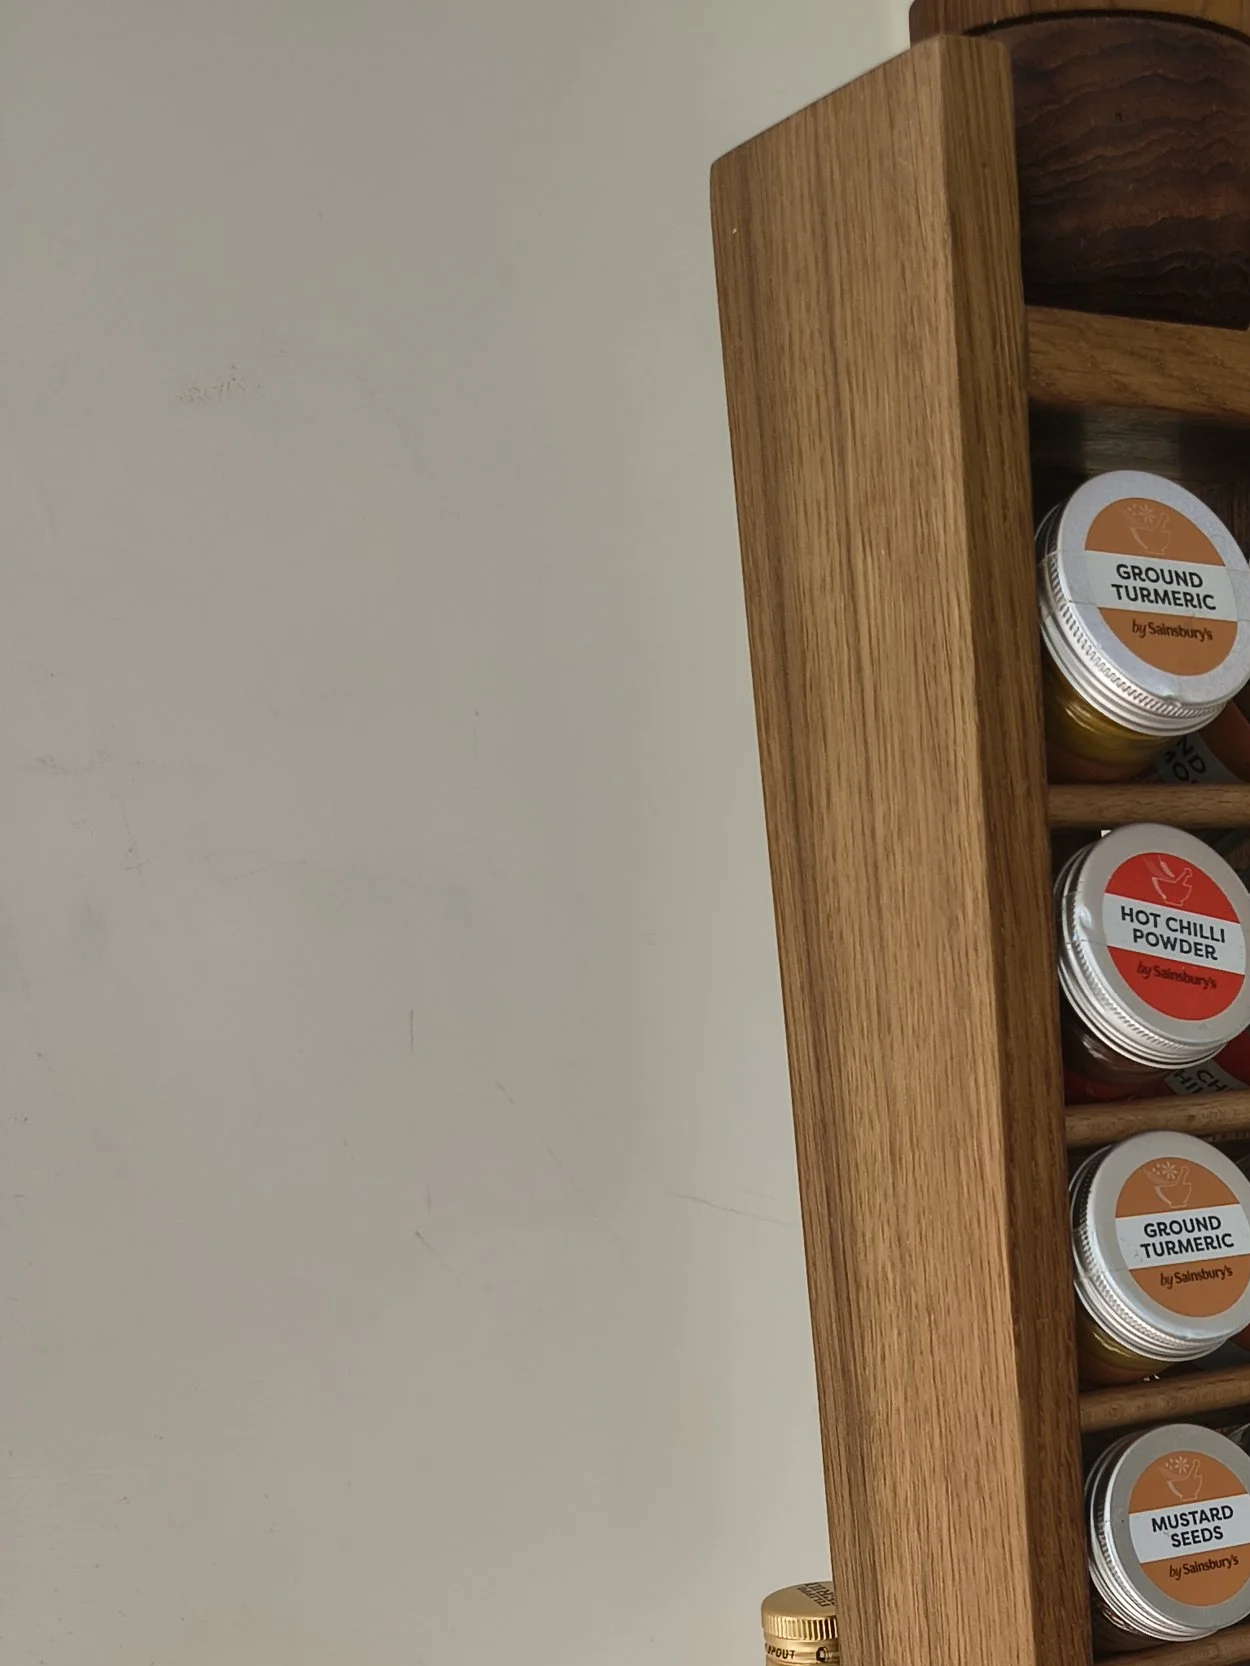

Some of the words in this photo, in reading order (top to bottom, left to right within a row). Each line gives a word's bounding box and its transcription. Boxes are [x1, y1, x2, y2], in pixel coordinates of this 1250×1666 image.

[1116, 563, 1204, 588] GROUND
[1111, 583, 1217, 611] TURMERIC
[1132, 620, 1147, 638] by
[1147, 623, 1213, 642] Sainsbury's
[1120, 905, 1160, 927] HOT
[1165, 916, 1225, 943] CHILLI
[1133, 928, 1218, 961] POWDER
[1137, 961, 1152, 979] by
[1153, 965, 1217, 990] Sainsbury's
[1143, 1216, 1222, 1238] GROUND
[1140, 1233, 1234, 1259] TURMERIC
[1160, 1272, 1174, 1287] by
[1175, 1265, 1233, 1284] Sainsbury's
[1151, 1505, 1234, 1532] MUSTARD
[1171, 1526, 1224, 1548] SEEDS
[1169, 1563, 1183, 1580] by
[1183, 1555, 1239, 1575] Sainsbury's
